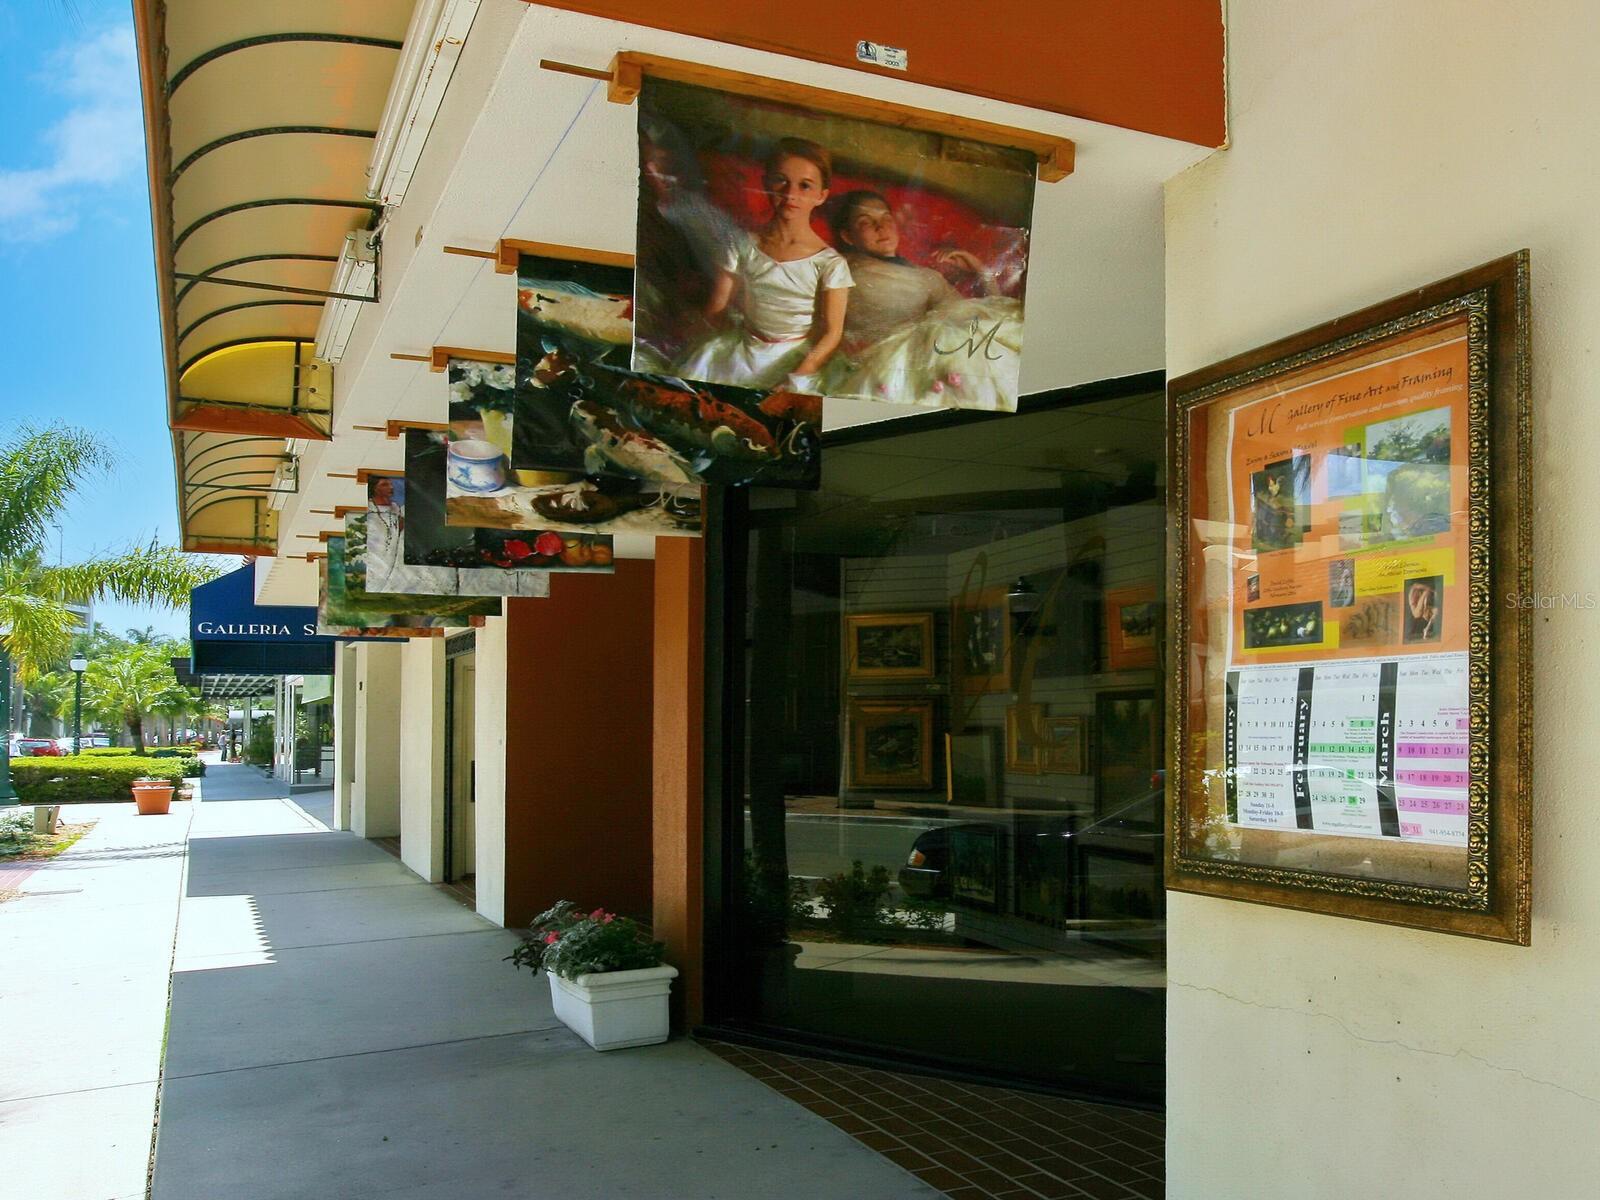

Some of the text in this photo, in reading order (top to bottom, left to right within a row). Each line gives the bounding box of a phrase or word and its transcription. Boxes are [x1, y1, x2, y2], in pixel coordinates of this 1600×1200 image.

[1338, 393, 1362, 405] Fine
[1363, 385, 1383, 399] Art
[1385, 382, 1400, 392] and
[1401, 367, 1453, 389] Framing
[197, 622, 292, 635] GALLERIA
[1296, 699, 1309, 798] February
[1379, 712, 1390, 786] March
